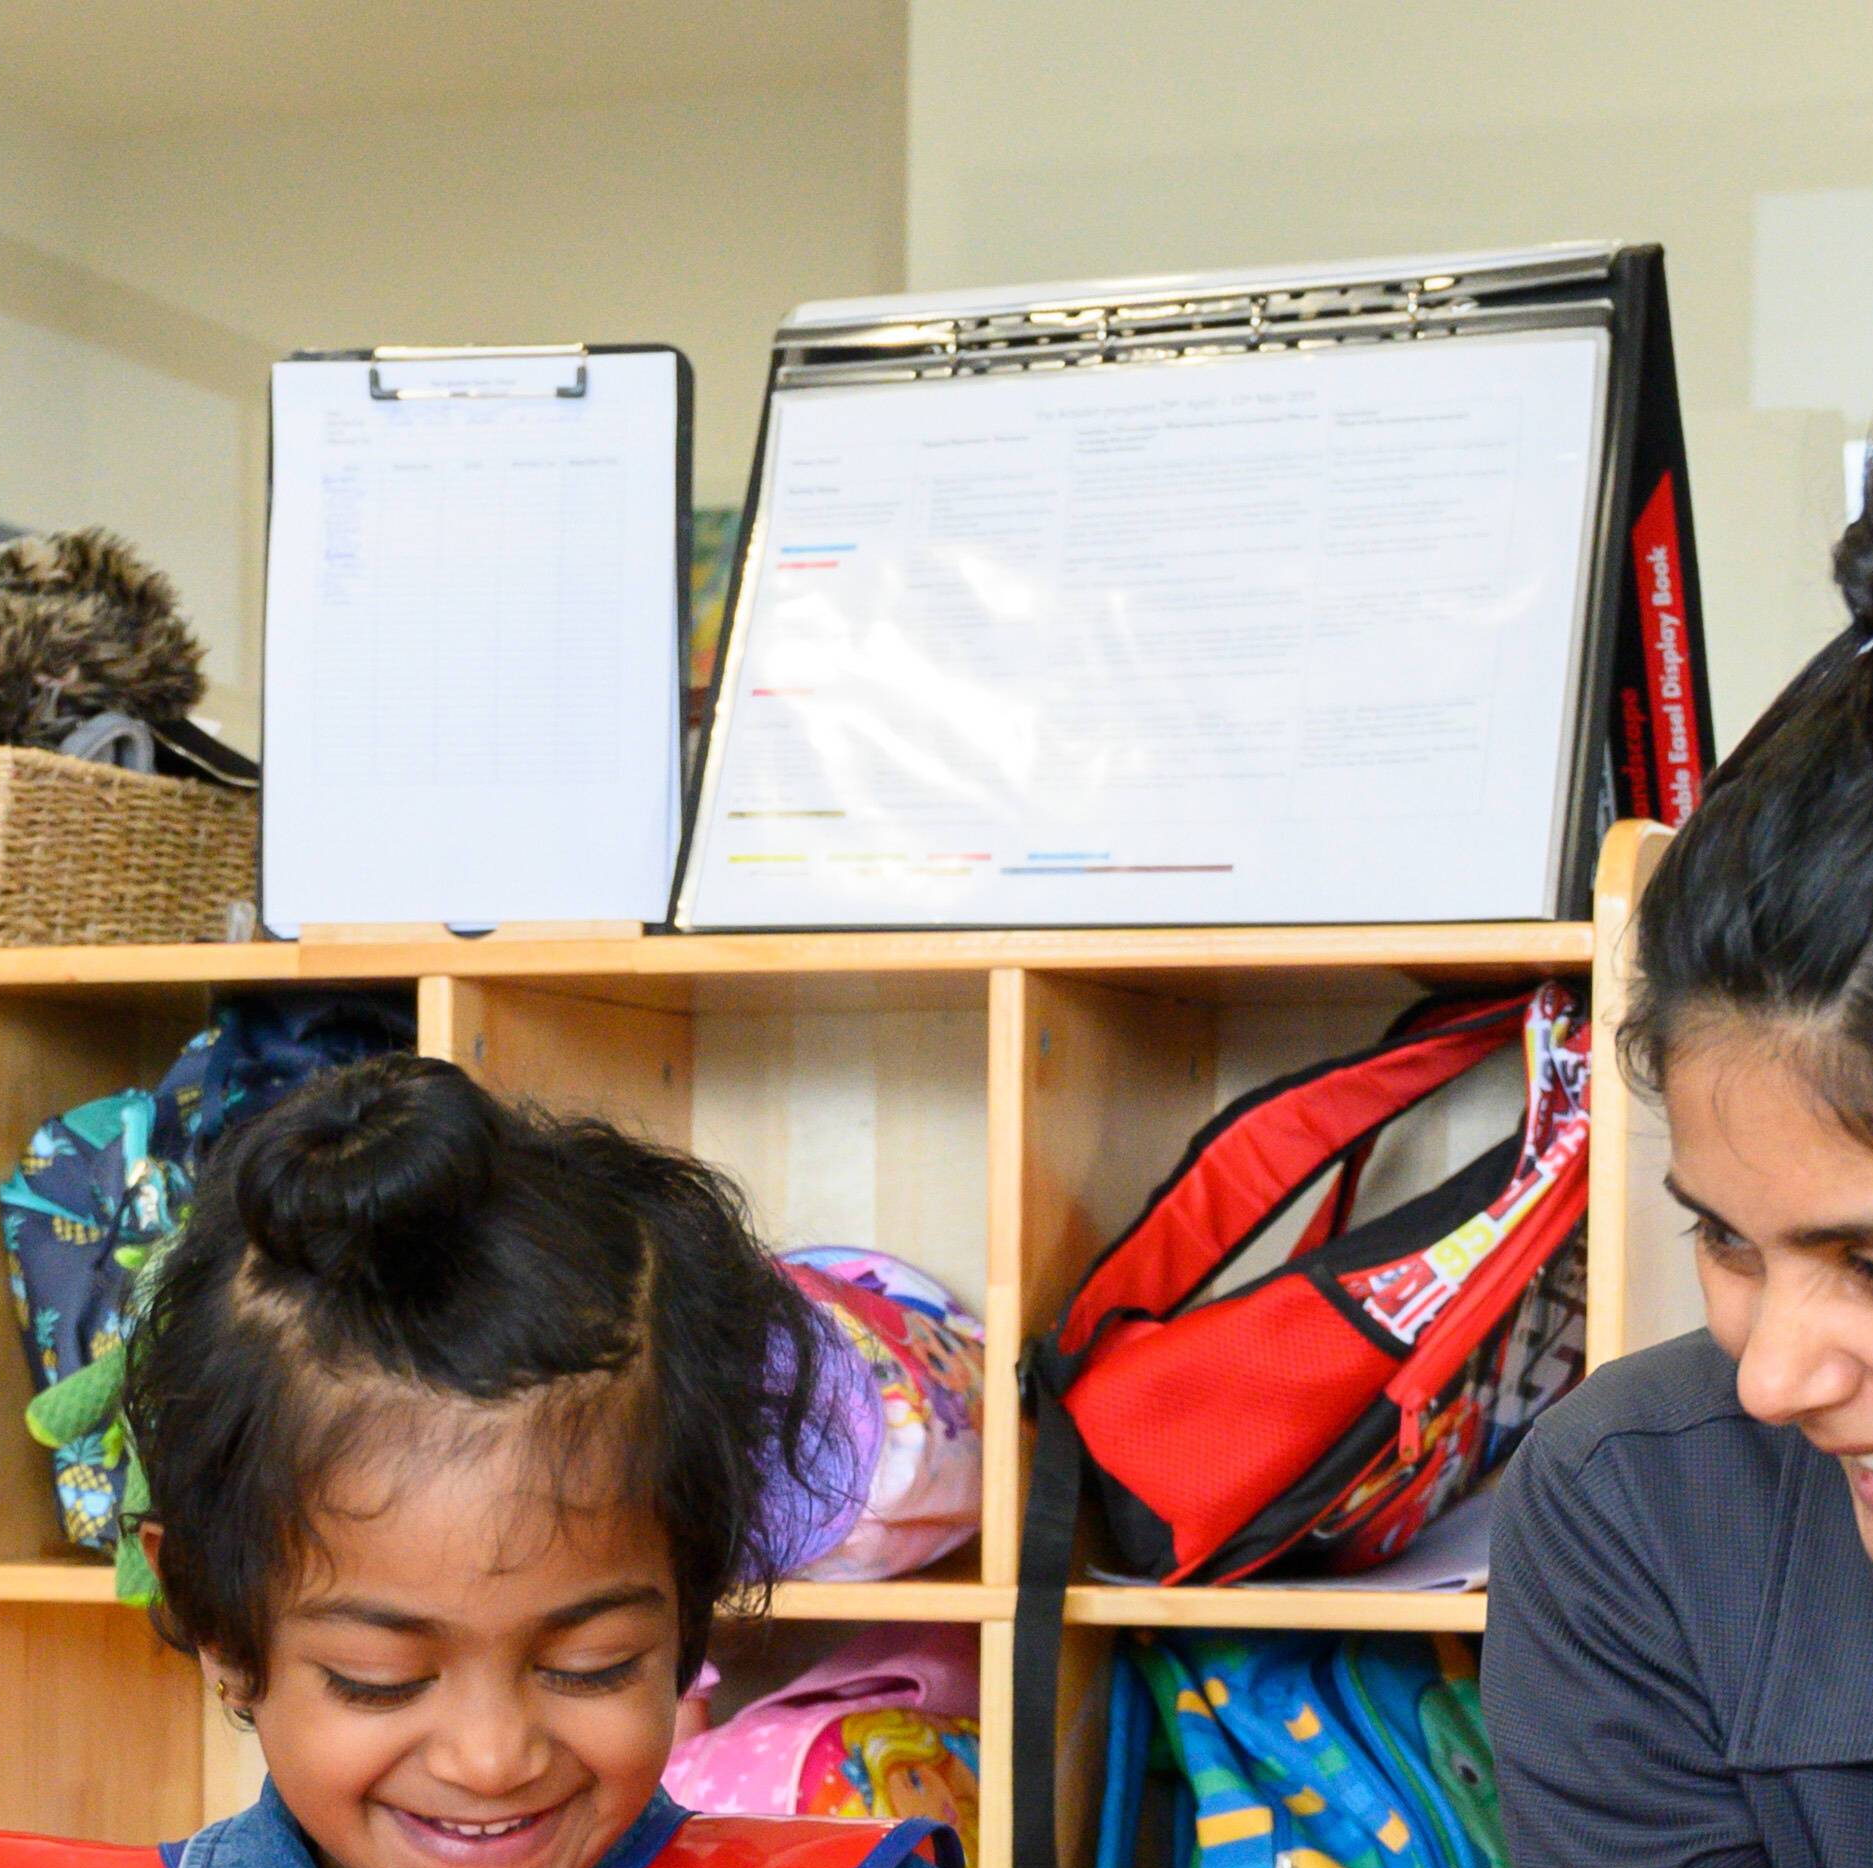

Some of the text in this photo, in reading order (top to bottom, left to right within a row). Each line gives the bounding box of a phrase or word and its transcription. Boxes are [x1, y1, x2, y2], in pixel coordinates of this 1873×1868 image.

[1645, 545, 1673, 607] Book
[1655, 612, 1685, 699] Display
[1662, 703, 1690, 764] Easel
